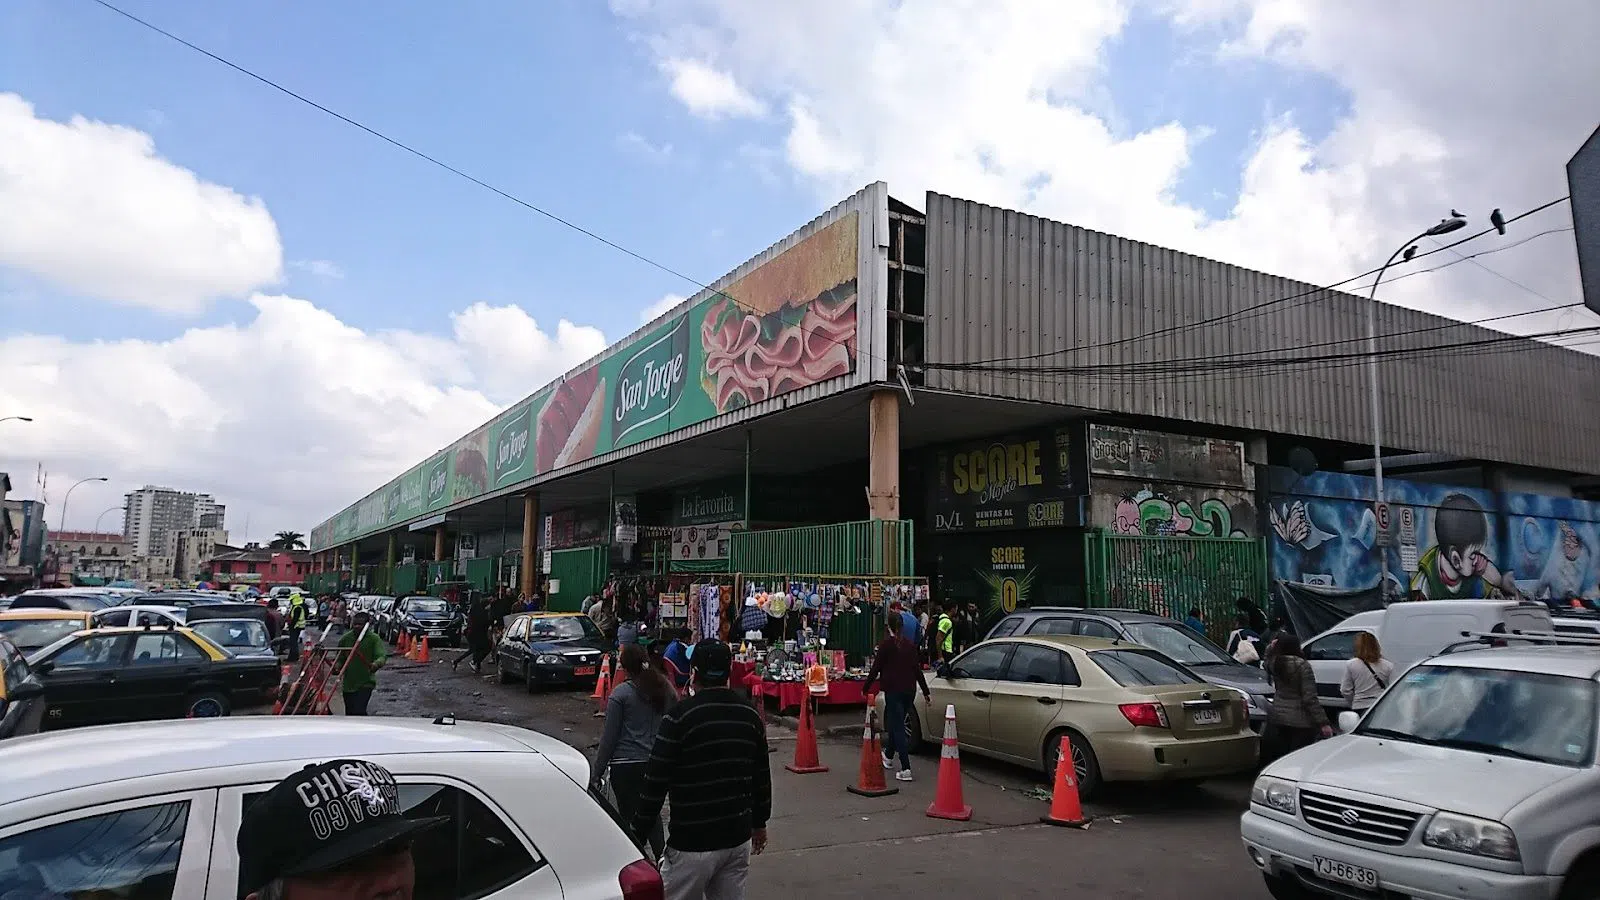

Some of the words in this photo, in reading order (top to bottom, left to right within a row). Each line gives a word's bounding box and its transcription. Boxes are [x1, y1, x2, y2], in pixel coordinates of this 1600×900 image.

[615, 377, 643, 422] San
[640, 352, 684, 411] Jorge
[496, 439, 510, 470] San
[507, 429, 528, 465] Jorge
[952, 440, 1043, 495] SCORE
[681, 497, 693, 518] La
[694, 490, 734, 516] Favorita
[980, 477, 1017, 504] Mojito
[975, 509, 1003, 519] VENTAS
[1003, 508, 1014, 516] AL
[975, 518, 990, 528] POR
[990, 517, 1014, 527] MAYOR
[1027, 500, 1064, 521] SCORE
[991, 546, 1025, 564] SCORE
[295, 761, 395, 809] CHIAGO
